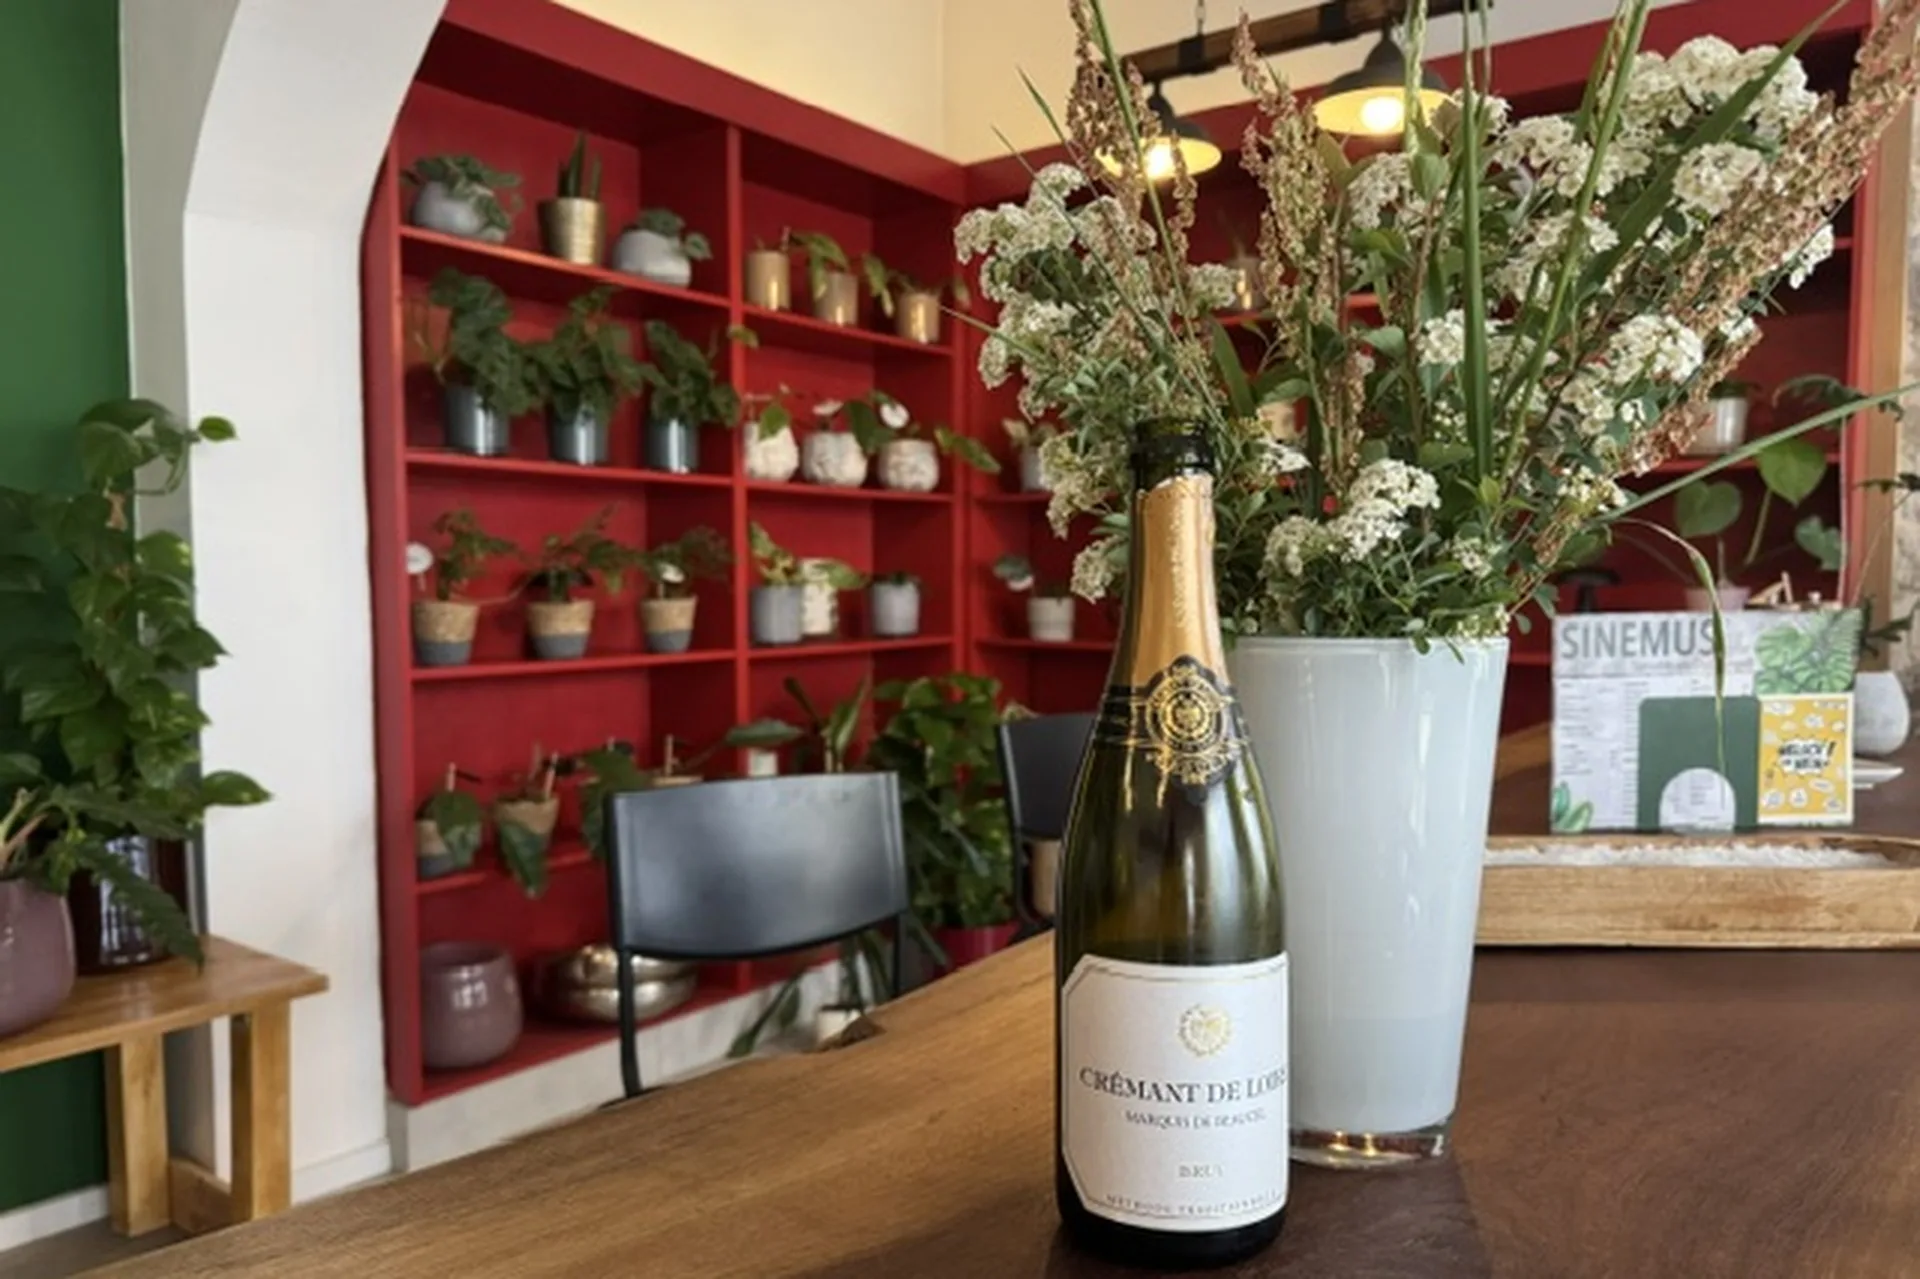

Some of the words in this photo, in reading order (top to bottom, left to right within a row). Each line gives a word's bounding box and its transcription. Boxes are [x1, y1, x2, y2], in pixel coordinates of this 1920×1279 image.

[1560, 618, 1715, 659] SINEMUS
[1078, 1066, 1200, 1103] CRÉMANT
[1207, 1081, 1241, 1103] DE
